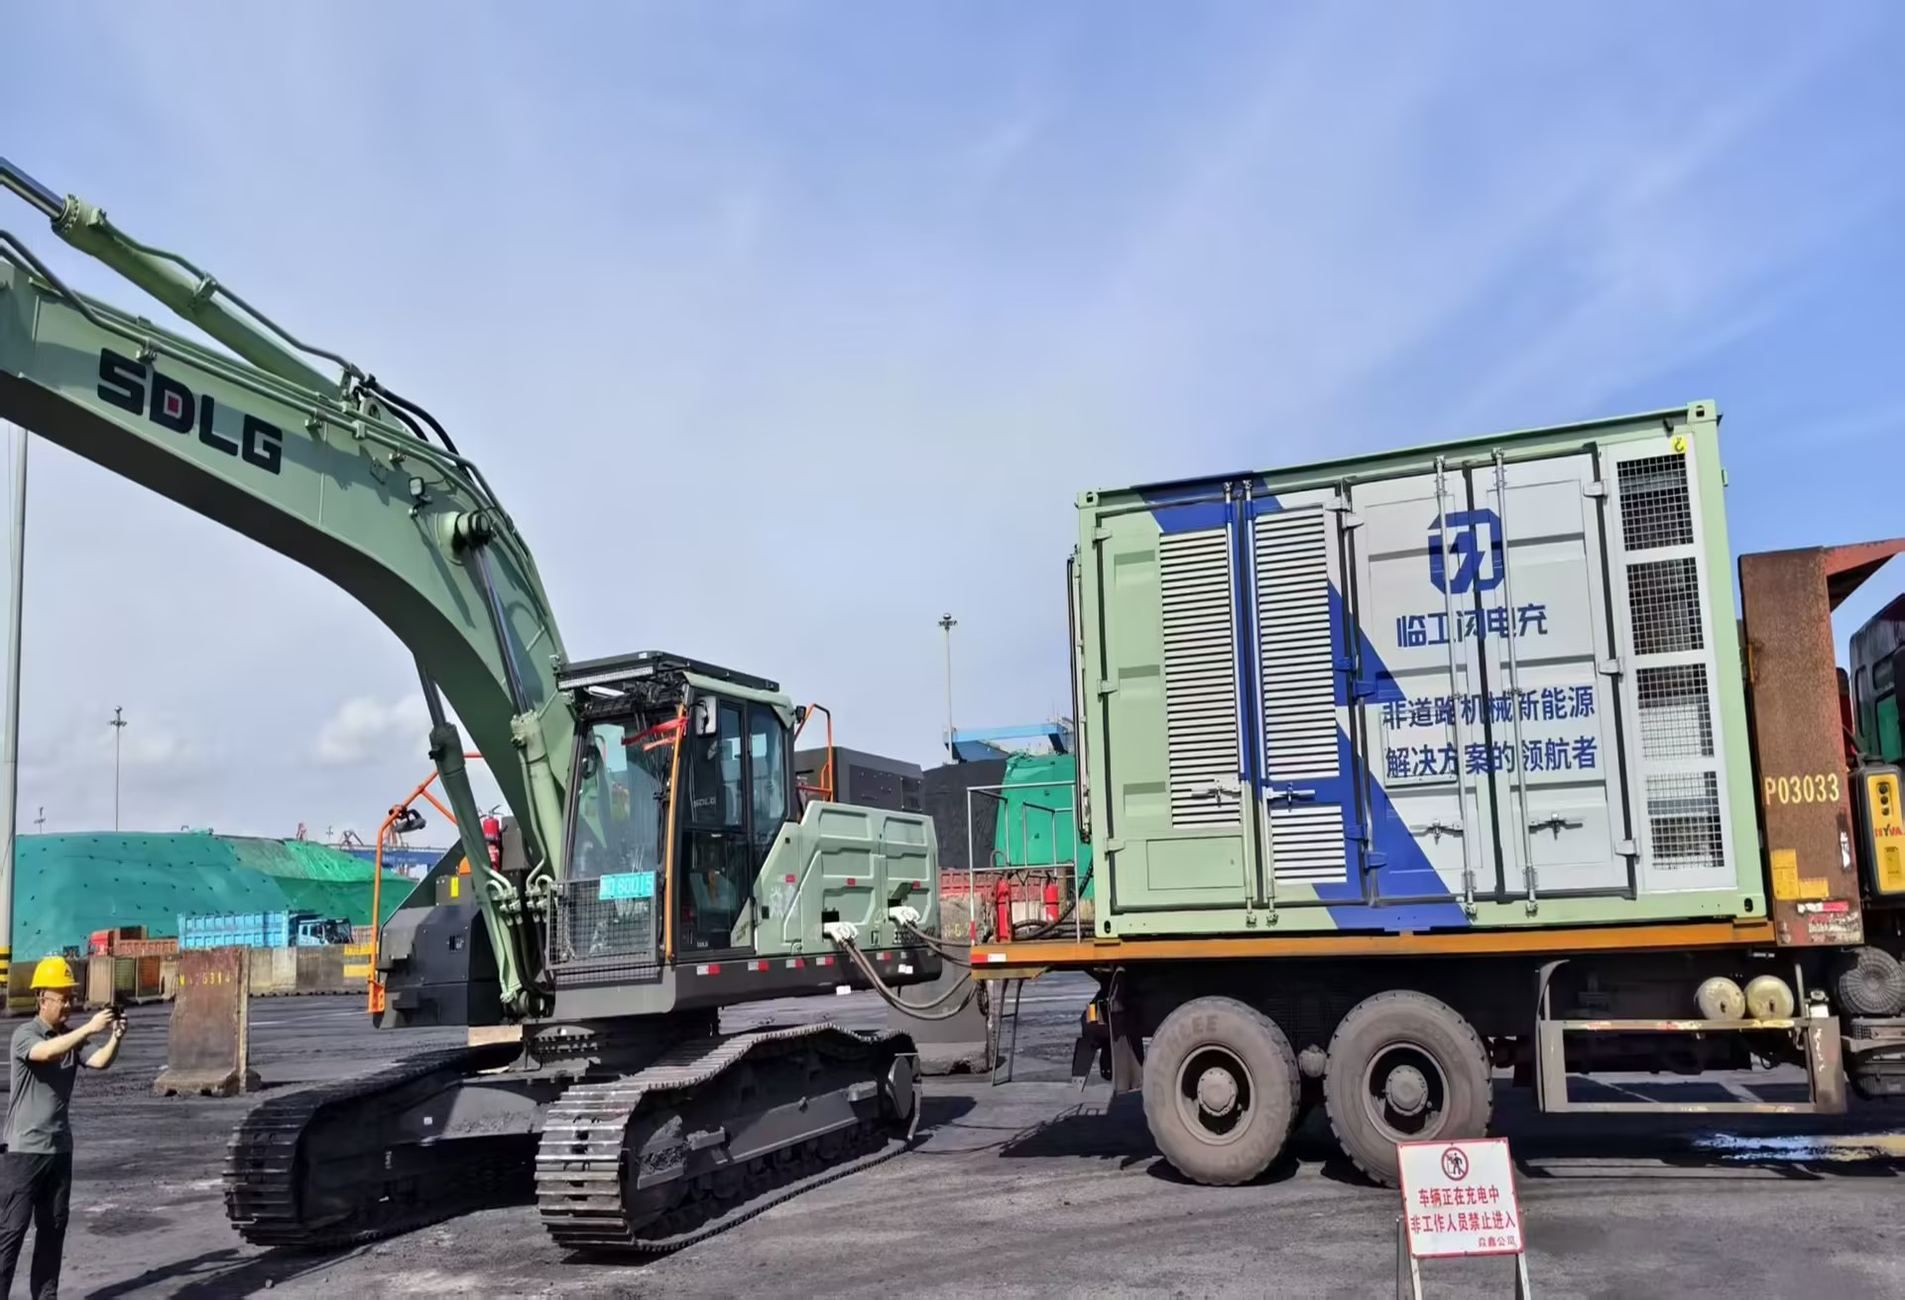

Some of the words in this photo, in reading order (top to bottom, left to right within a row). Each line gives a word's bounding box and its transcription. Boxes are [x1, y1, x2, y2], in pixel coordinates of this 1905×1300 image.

[97, 348, 282, 475] SDLG
[1396, 603, 1548, 648] 临工闪电充
[1383, 686, 1594, 730] 非道路机械新能源
[1386, 736, 1597, 778] 解决方案的领航者
[1765, 773, 1840, 805] P03033
[1419, 1185, 1499, 1207] 车辆正在充电中
[1411, 1212, 1516, 1234] 非工作人员禁止进入
